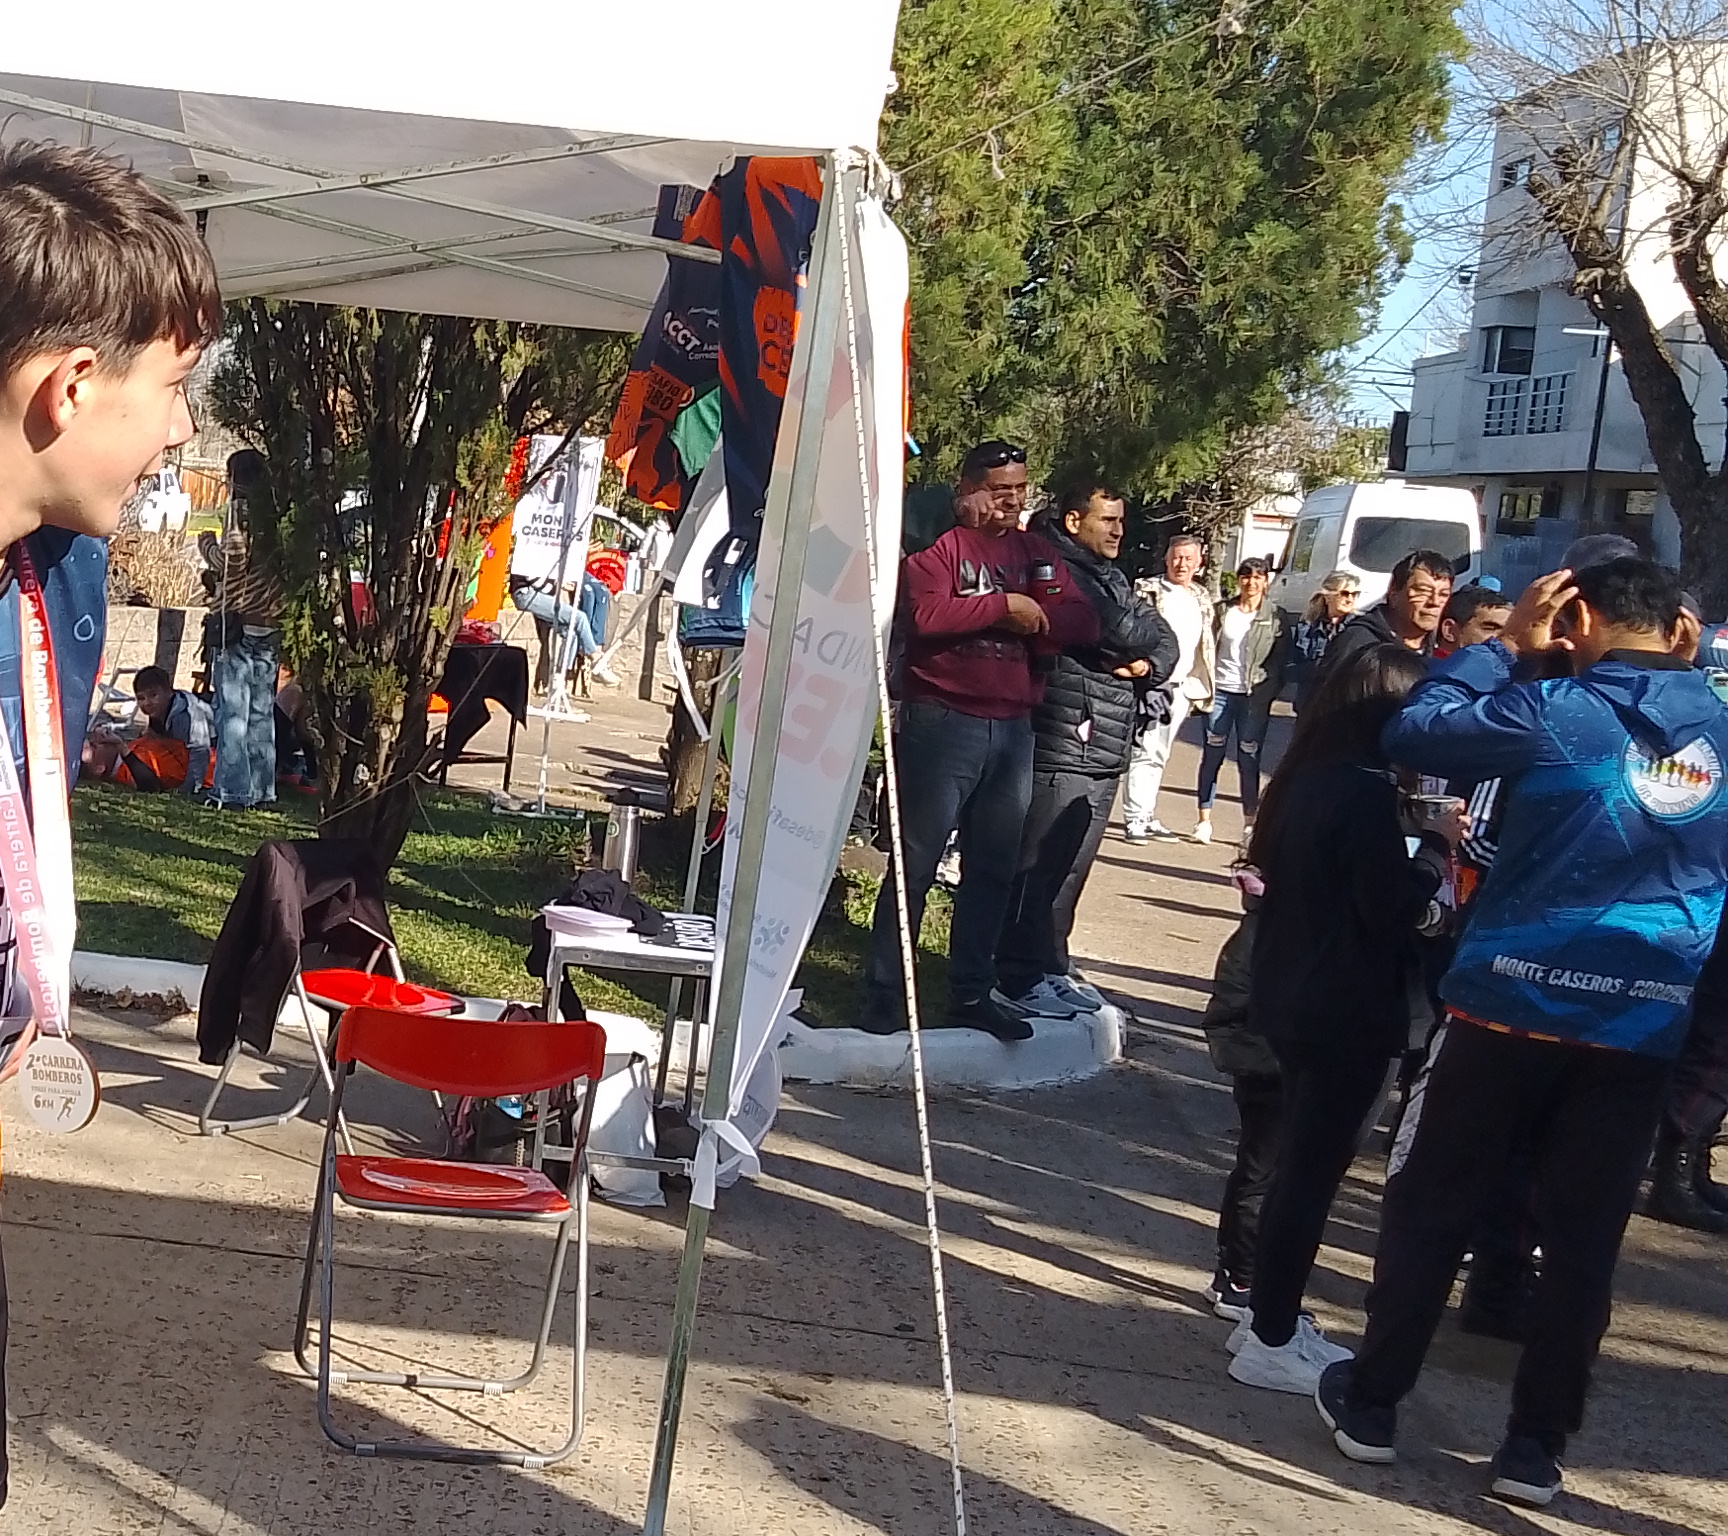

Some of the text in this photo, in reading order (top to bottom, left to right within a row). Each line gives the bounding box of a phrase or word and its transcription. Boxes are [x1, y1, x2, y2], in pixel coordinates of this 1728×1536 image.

[531, 513, 577, 528] MONE
[522, 525, 584, 542] CASERS
[28, 618, 45, 646] de
[1491, 954, 1549, 983] MONTE
[41, 1054, 84, 1071] CARRERA
[32, 1068, 83, 1084] BOMBEROS
